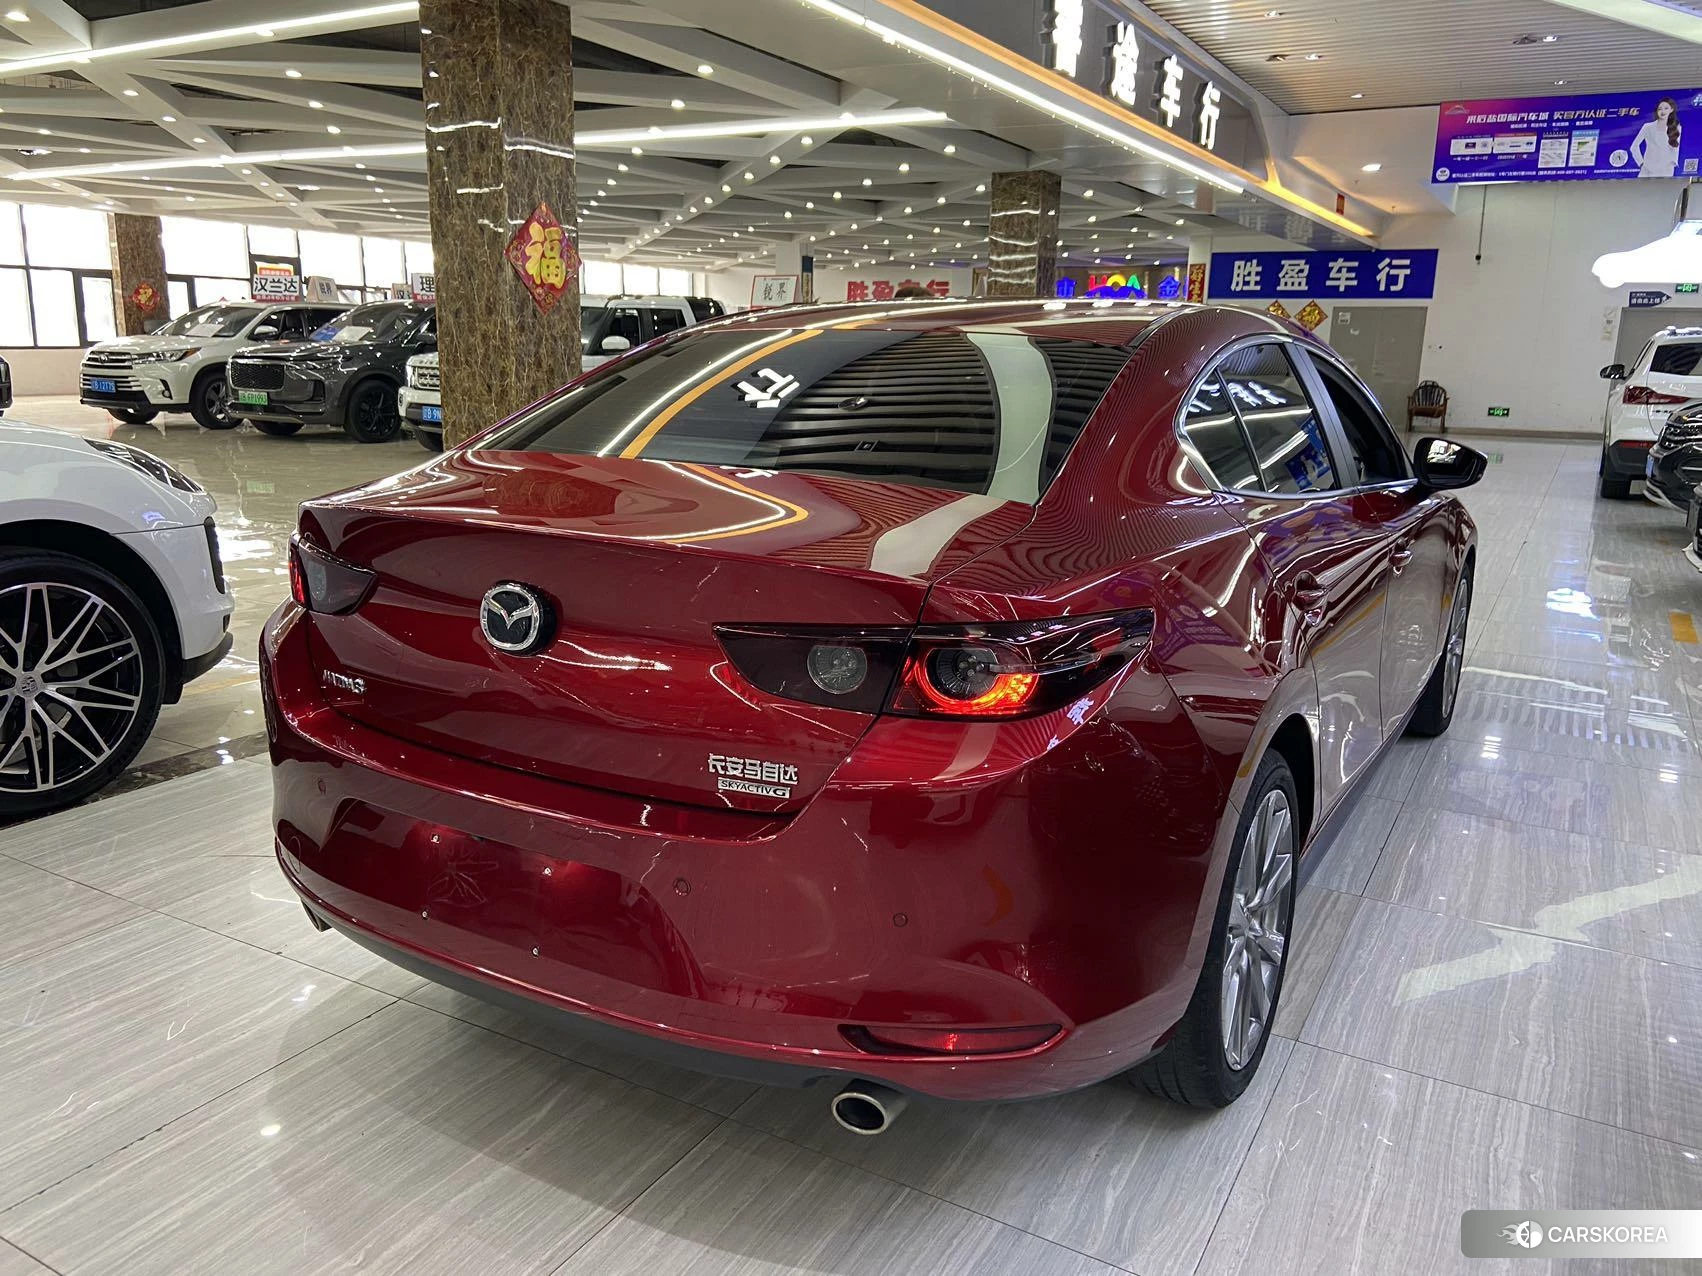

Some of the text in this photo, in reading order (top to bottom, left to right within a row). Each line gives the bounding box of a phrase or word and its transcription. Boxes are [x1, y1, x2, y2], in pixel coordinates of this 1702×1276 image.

[525, 222, 566, 290] 福
[254, 277, 298, 294] 汉兰达
[1231, 258, 1411, 292] 胜盈车行
[763, 282, 787, 301] 锐界
[708, 753, 798, 785] 长安马自达
